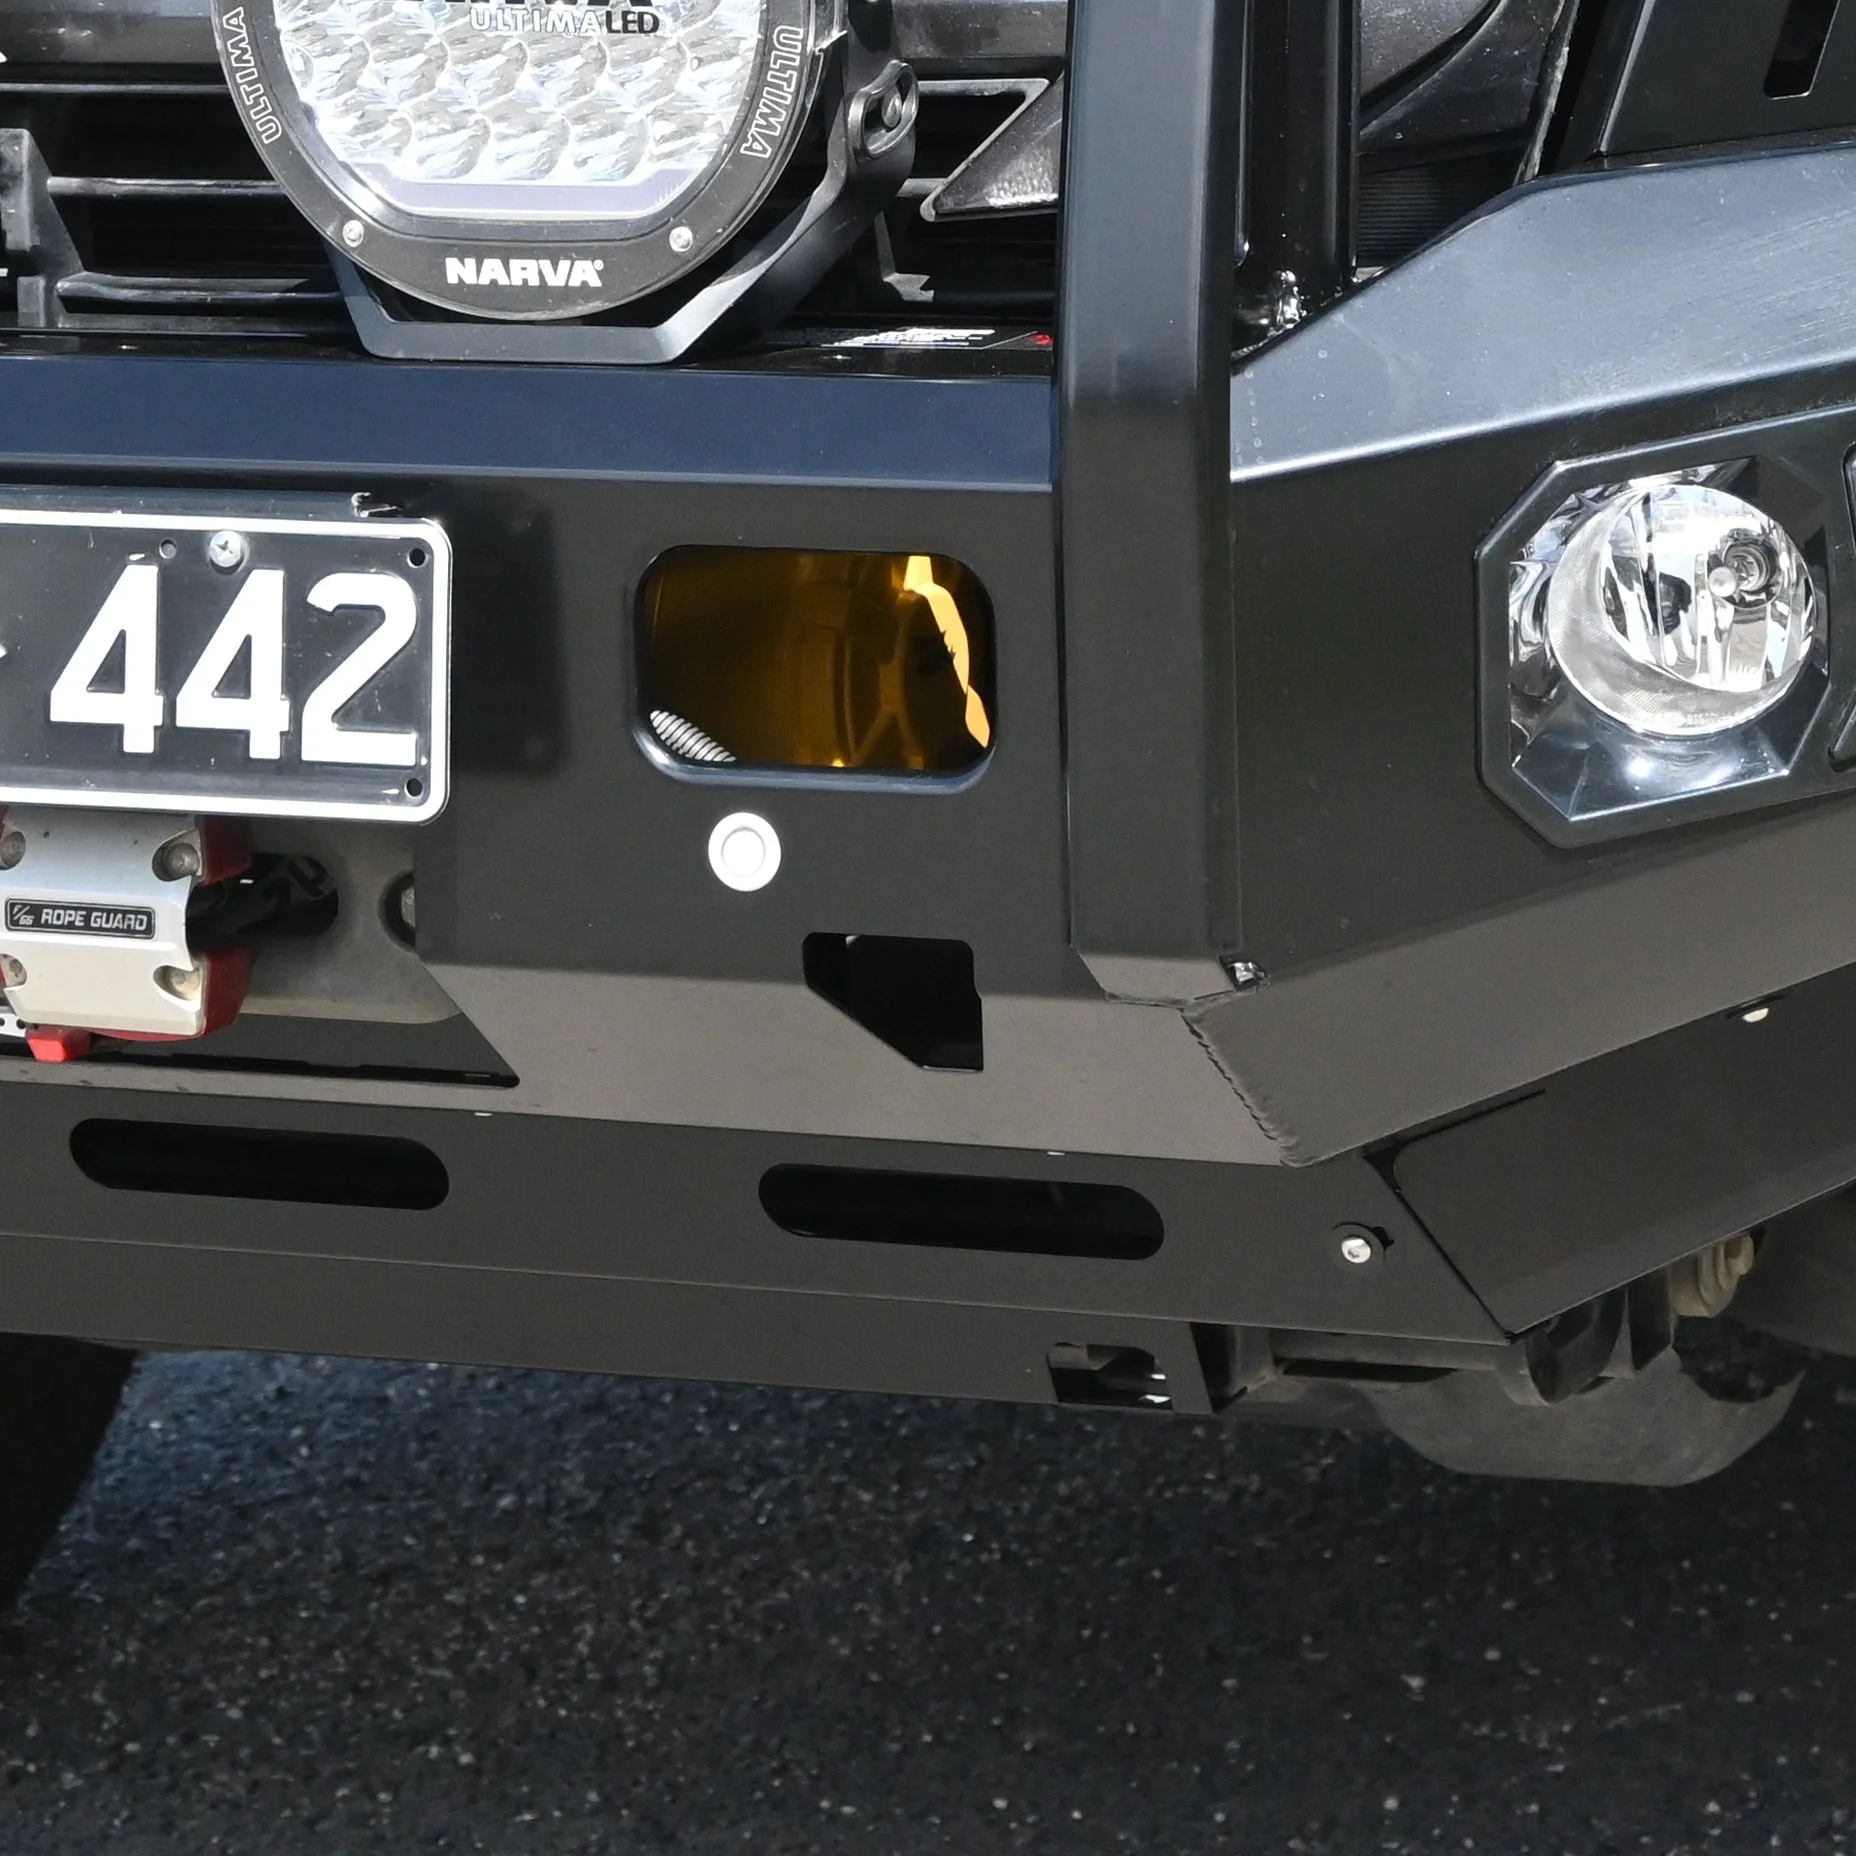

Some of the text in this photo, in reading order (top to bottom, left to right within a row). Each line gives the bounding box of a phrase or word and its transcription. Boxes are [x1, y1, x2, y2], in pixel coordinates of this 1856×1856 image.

[223, 6, 282, 144] ULTIMA
[739, 25, 804, 159] ULTIMA
[41, 908, 86, 927] ROPE
[90, 912, 147, 931] GUARD
